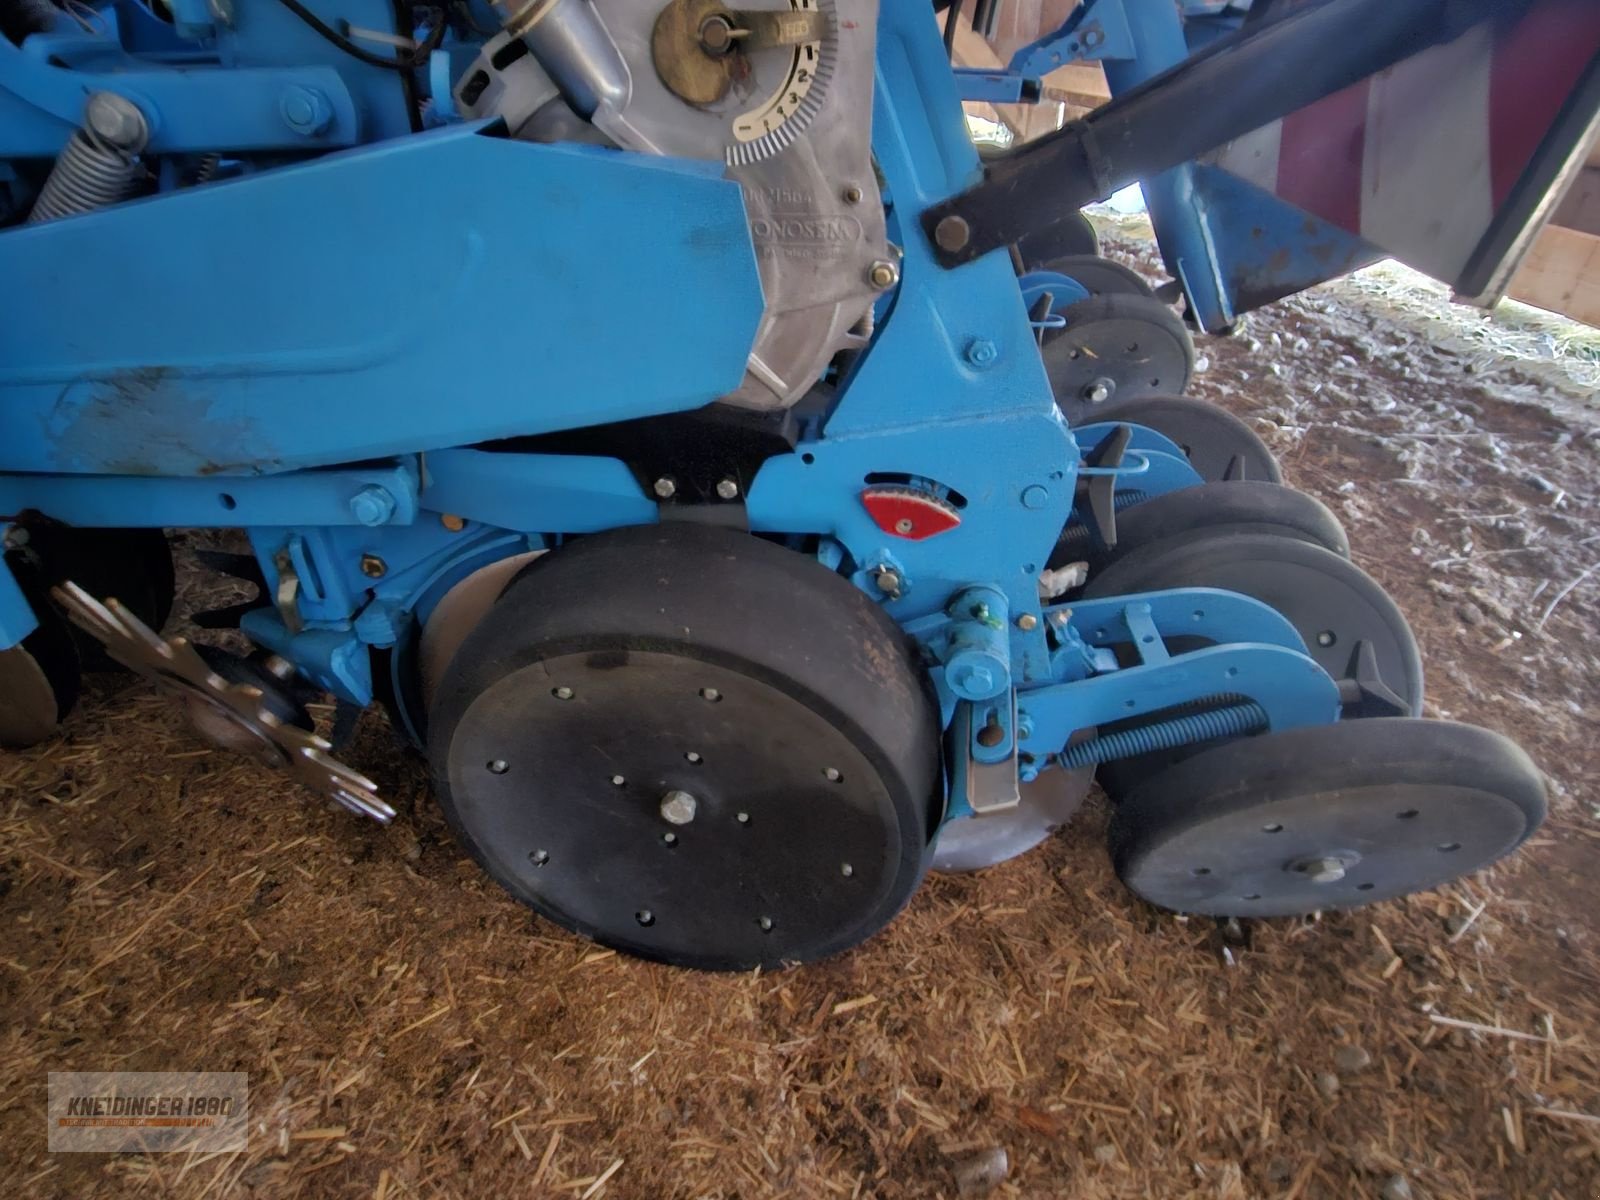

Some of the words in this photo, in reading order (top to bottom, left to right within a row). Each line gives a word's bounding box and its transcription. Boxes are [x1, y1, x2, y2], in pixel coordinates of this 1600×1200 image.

[797, 69, 808, 83] 2
[789, 92, 798, 104] 3
[753, 218, 852, 242] ONOSEM
